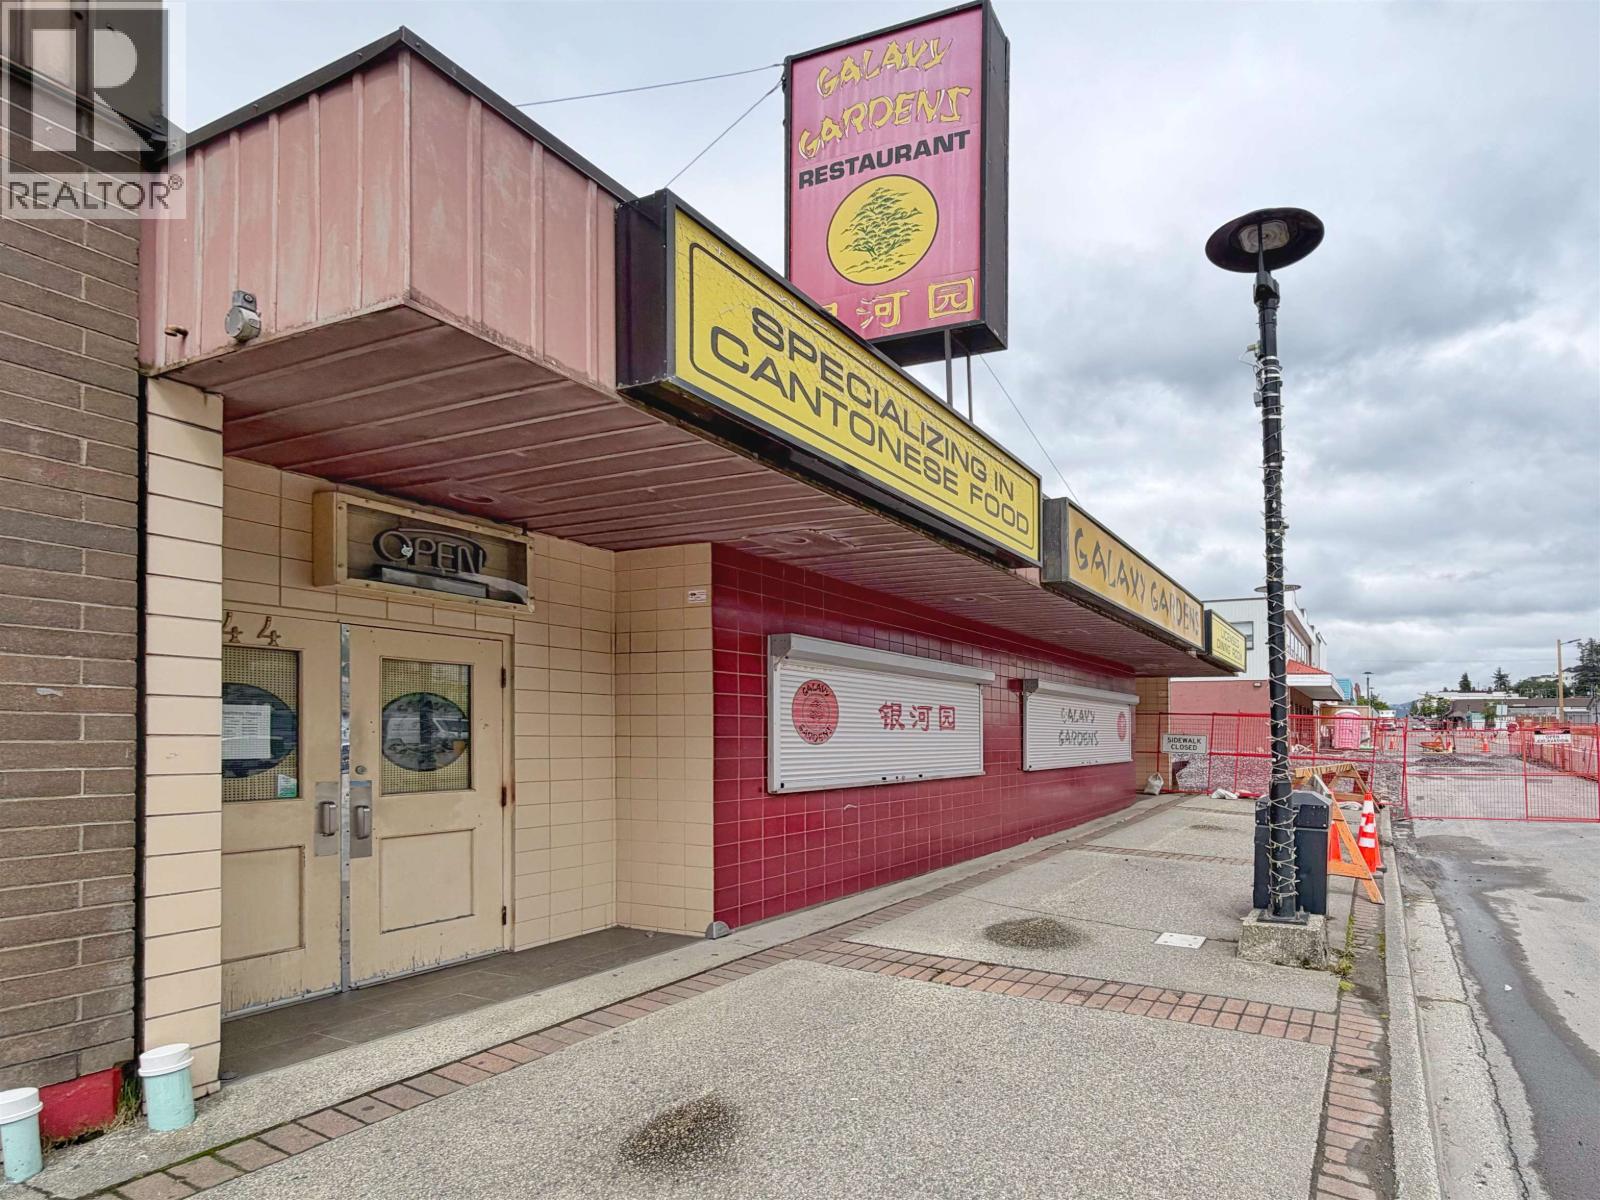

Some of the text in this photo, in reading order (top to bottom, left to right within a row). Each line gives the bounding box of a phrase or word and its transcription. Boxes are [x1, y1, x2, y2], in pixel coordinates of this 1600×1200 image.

[799, 86, 972, 160] GARDENS
[798, 130, 971, 190] RESTAURANT
[821, 276, 975, 329] 河园
[711, 326, 1029, 535] CANTONESE FOOD
[752, 307, 1014, 501] SPECIALIZING IN
[379, 530, 483, 576] OPEN
[1074, 527, 1200, 636] GALAXY GARDENS
[878, 701, 956, 731] 银河园
[1058, 729, 1099, 746] GARDENS
[1167, 736, 1202, 745] SIDEWALK
[1170, 743, 1198, 751] CLOSED
